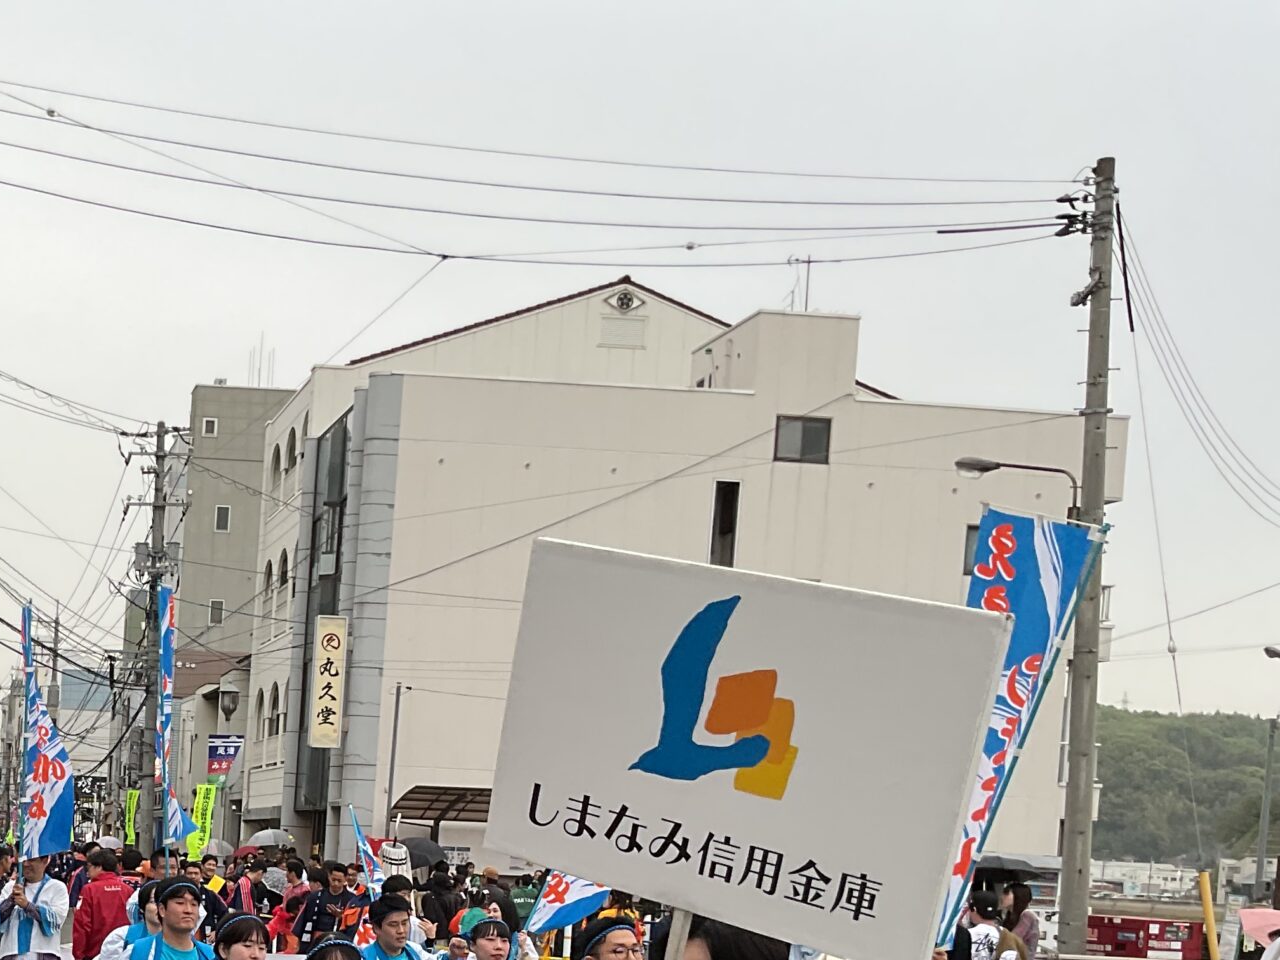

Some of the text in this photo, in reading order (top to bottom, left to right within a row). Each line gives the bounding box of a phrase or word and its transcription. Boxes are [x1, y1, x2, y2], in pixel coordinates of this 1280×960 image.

[317, 657, 339, 726] 丸久堂
[211, 761, 233, 770] みな
[528, 781, 884, 921] しまなみ信用金庫
